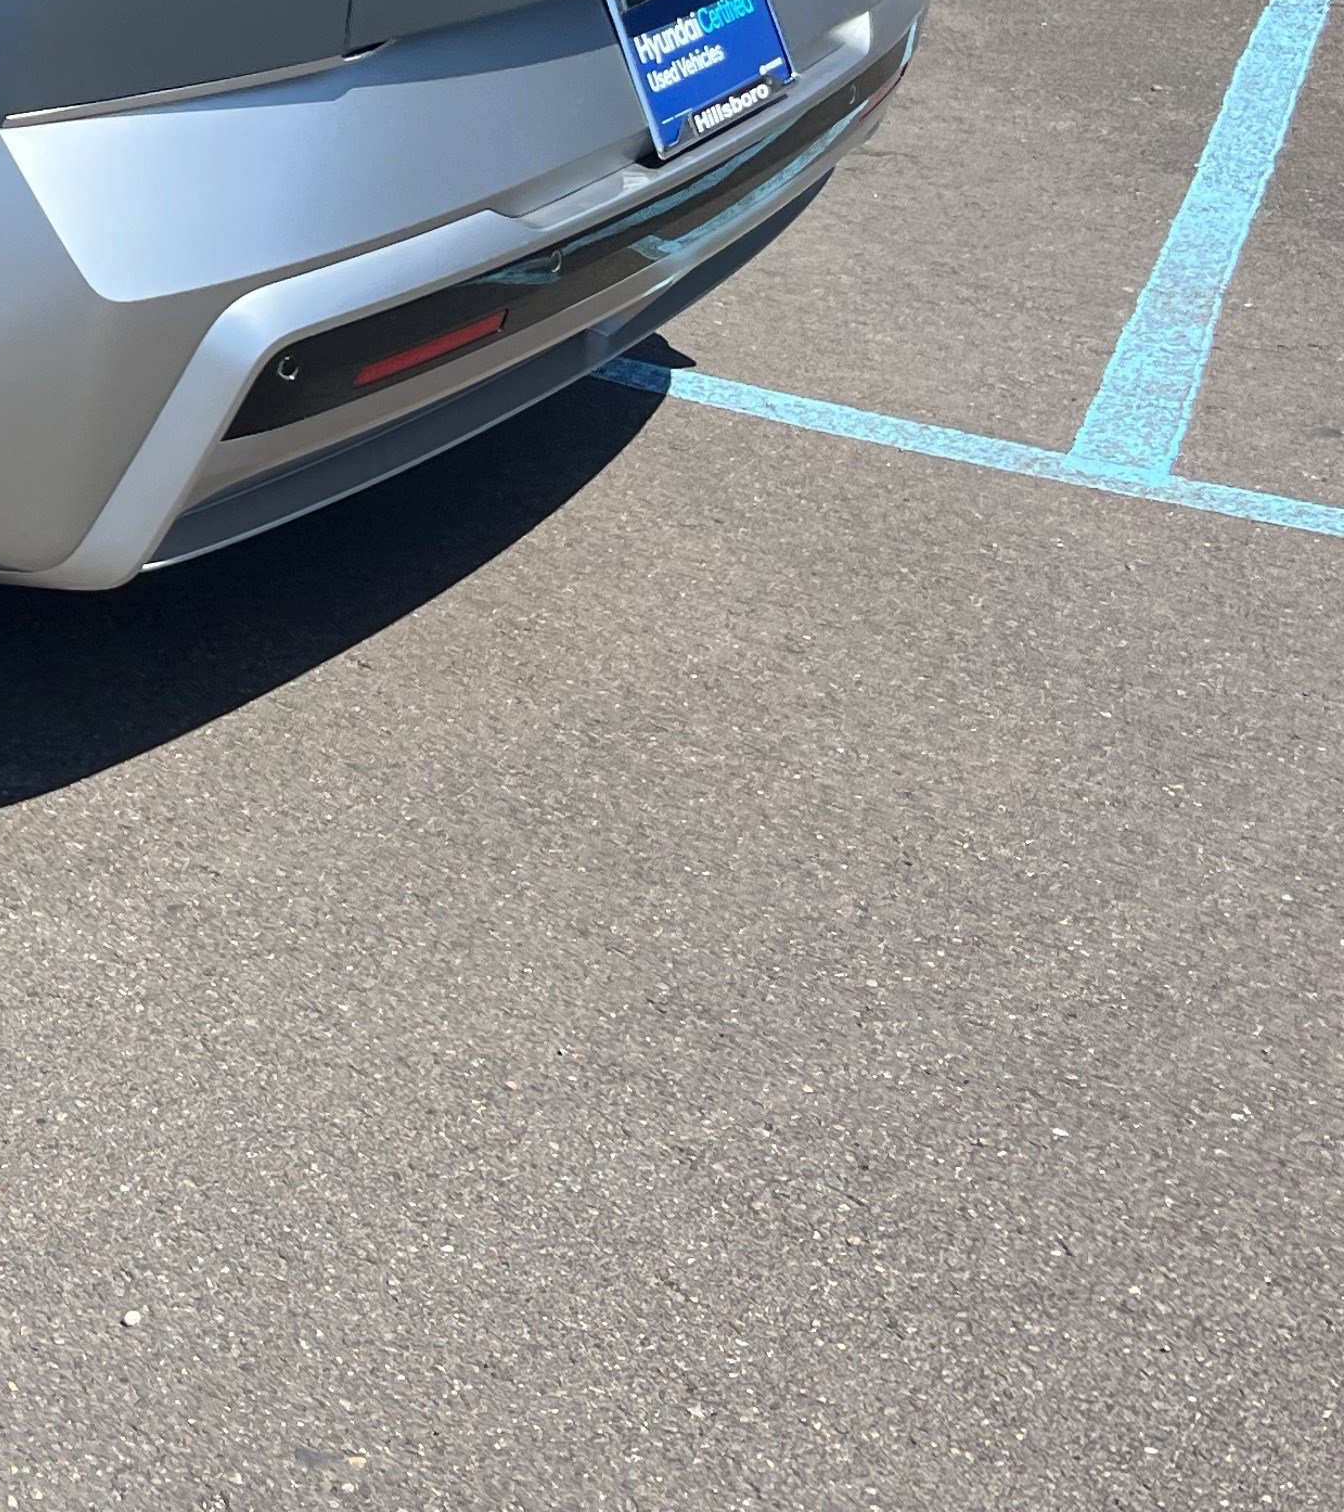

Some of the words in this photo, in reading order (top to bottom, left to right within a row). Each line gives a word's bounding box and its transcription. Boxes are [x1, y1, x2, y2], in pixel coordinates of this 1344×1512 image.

[646, 61, 681, 93] Used
[675, 44, 726, 78] Vehicles
[693, 83, 770, 134] Hillsboro
